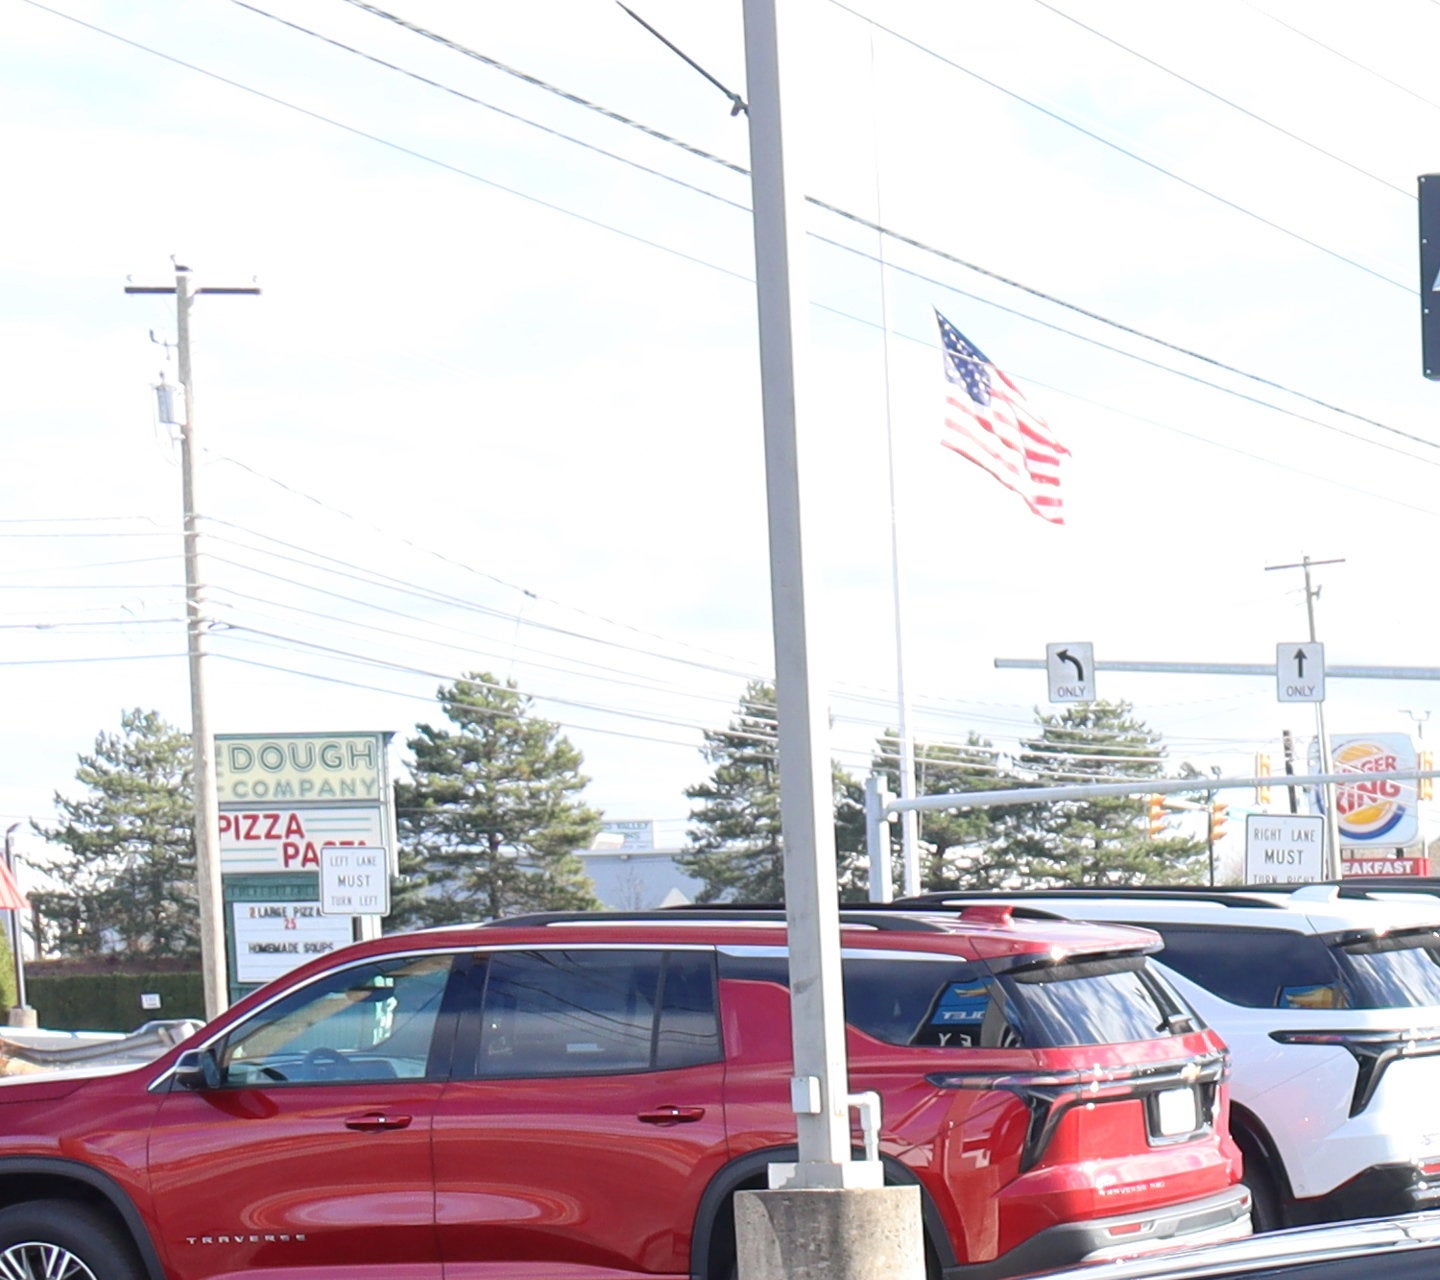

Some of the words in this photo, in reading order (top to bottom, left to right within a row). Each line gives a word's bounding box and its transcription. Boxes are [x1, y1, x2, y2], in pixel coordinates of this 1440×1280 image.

[1057, 685, 1086, 698] ONLY
[1286, 685, 1316, 698] ONLY
[228, 741, 376, 774] DOUGH
[232, 778, 377, 799] COMPANY
[219, 813, 305, 840] PIZZA
[1254, 828, 1282, 841] RIGHT
[1291, 829, 1315, 842] LANE
[330, 856, 349, 867] LEFT
[356, 855, 377, 867] LANE
[1264, 850, 1304, 865] MUST
[1343, 861, 1414, 875] EAKFAST
[337, 875, 371, 888] MUST
[331, 895, 352, 906] TURN
[359, 895, 378, 906] LEFT
[284, 918, 297, 930] 25
[248, 942, 298, 954] HOMEMADE
[303, 941, 335, 953] SOUPS
[186, 1234, 306, 1244] TRAVERSE
